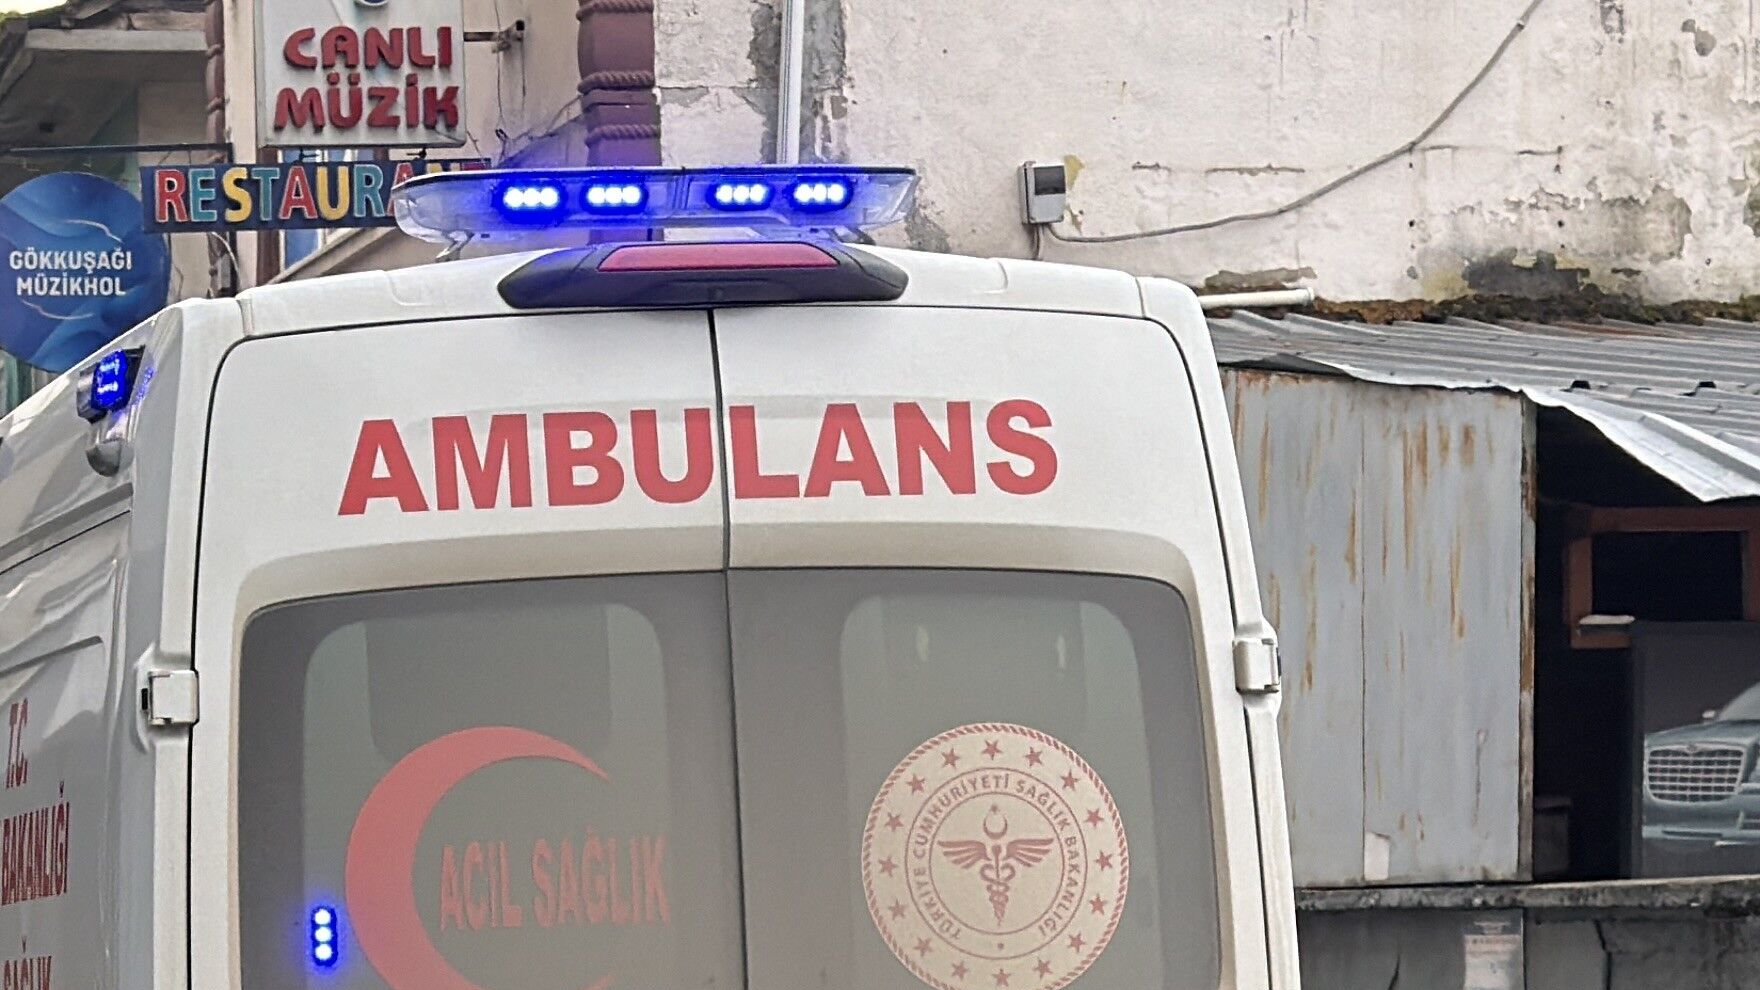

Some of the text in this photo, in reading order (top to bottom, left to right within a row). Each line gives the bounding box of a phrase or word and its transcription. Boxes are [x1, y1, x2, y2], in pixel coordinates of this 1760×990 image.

[283, 26, 452, 69] CANLI
[273, 72, 459, 131] MÜZİK
[155, 162, 492, 223] RESTAUR
[9, 246, 132, 274] GÖKKUŞAĞI
[16, 273, 126, 296] MÜZİKHOL
[338, 398, 1059, 515] AMBULANS
[1, 780, 70, 906] BAKANLIĞI
[912, 773, 1081, 940] TÜRKİYE CUMHURİYETİ SAĞLIK BAKANLIĞI
[531, 822, 671, 928] SAĞLIK
